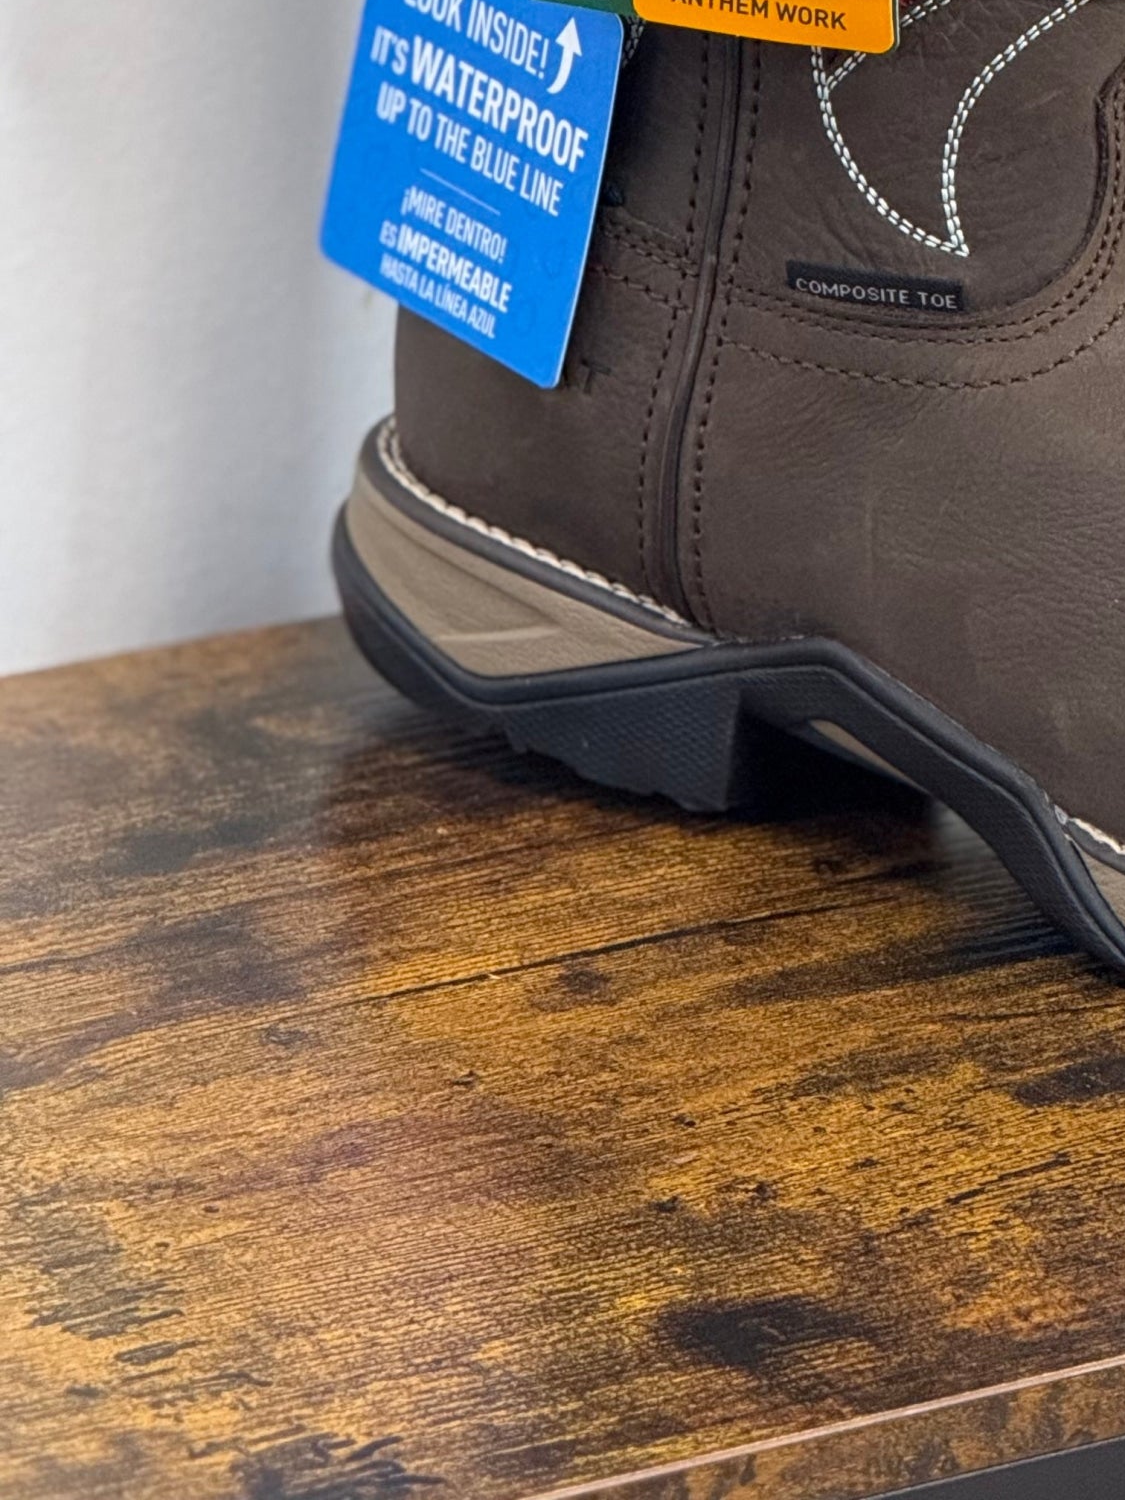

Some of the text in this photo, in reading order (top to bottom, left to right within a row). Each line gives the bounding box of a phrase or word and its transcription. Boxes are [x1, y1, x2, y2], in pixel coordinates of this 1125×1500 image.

[776, 1, 847, 31] WORK
[370, 24, 589, 173] IT'S WATERPROOF
[376, 81, 564, 217] UP TO THE BLUE LINE
[379, 219, 512, 313] ES IMPERMEABLE
[444, 206, 508, 265] DENTRO!
[379, 252, 418, 293] HASTA
[418, 274, 434, 303] LA
[467, 305, 496, 339] AZUL
[795, 277, 958, 309] COMPOSITE TOE
